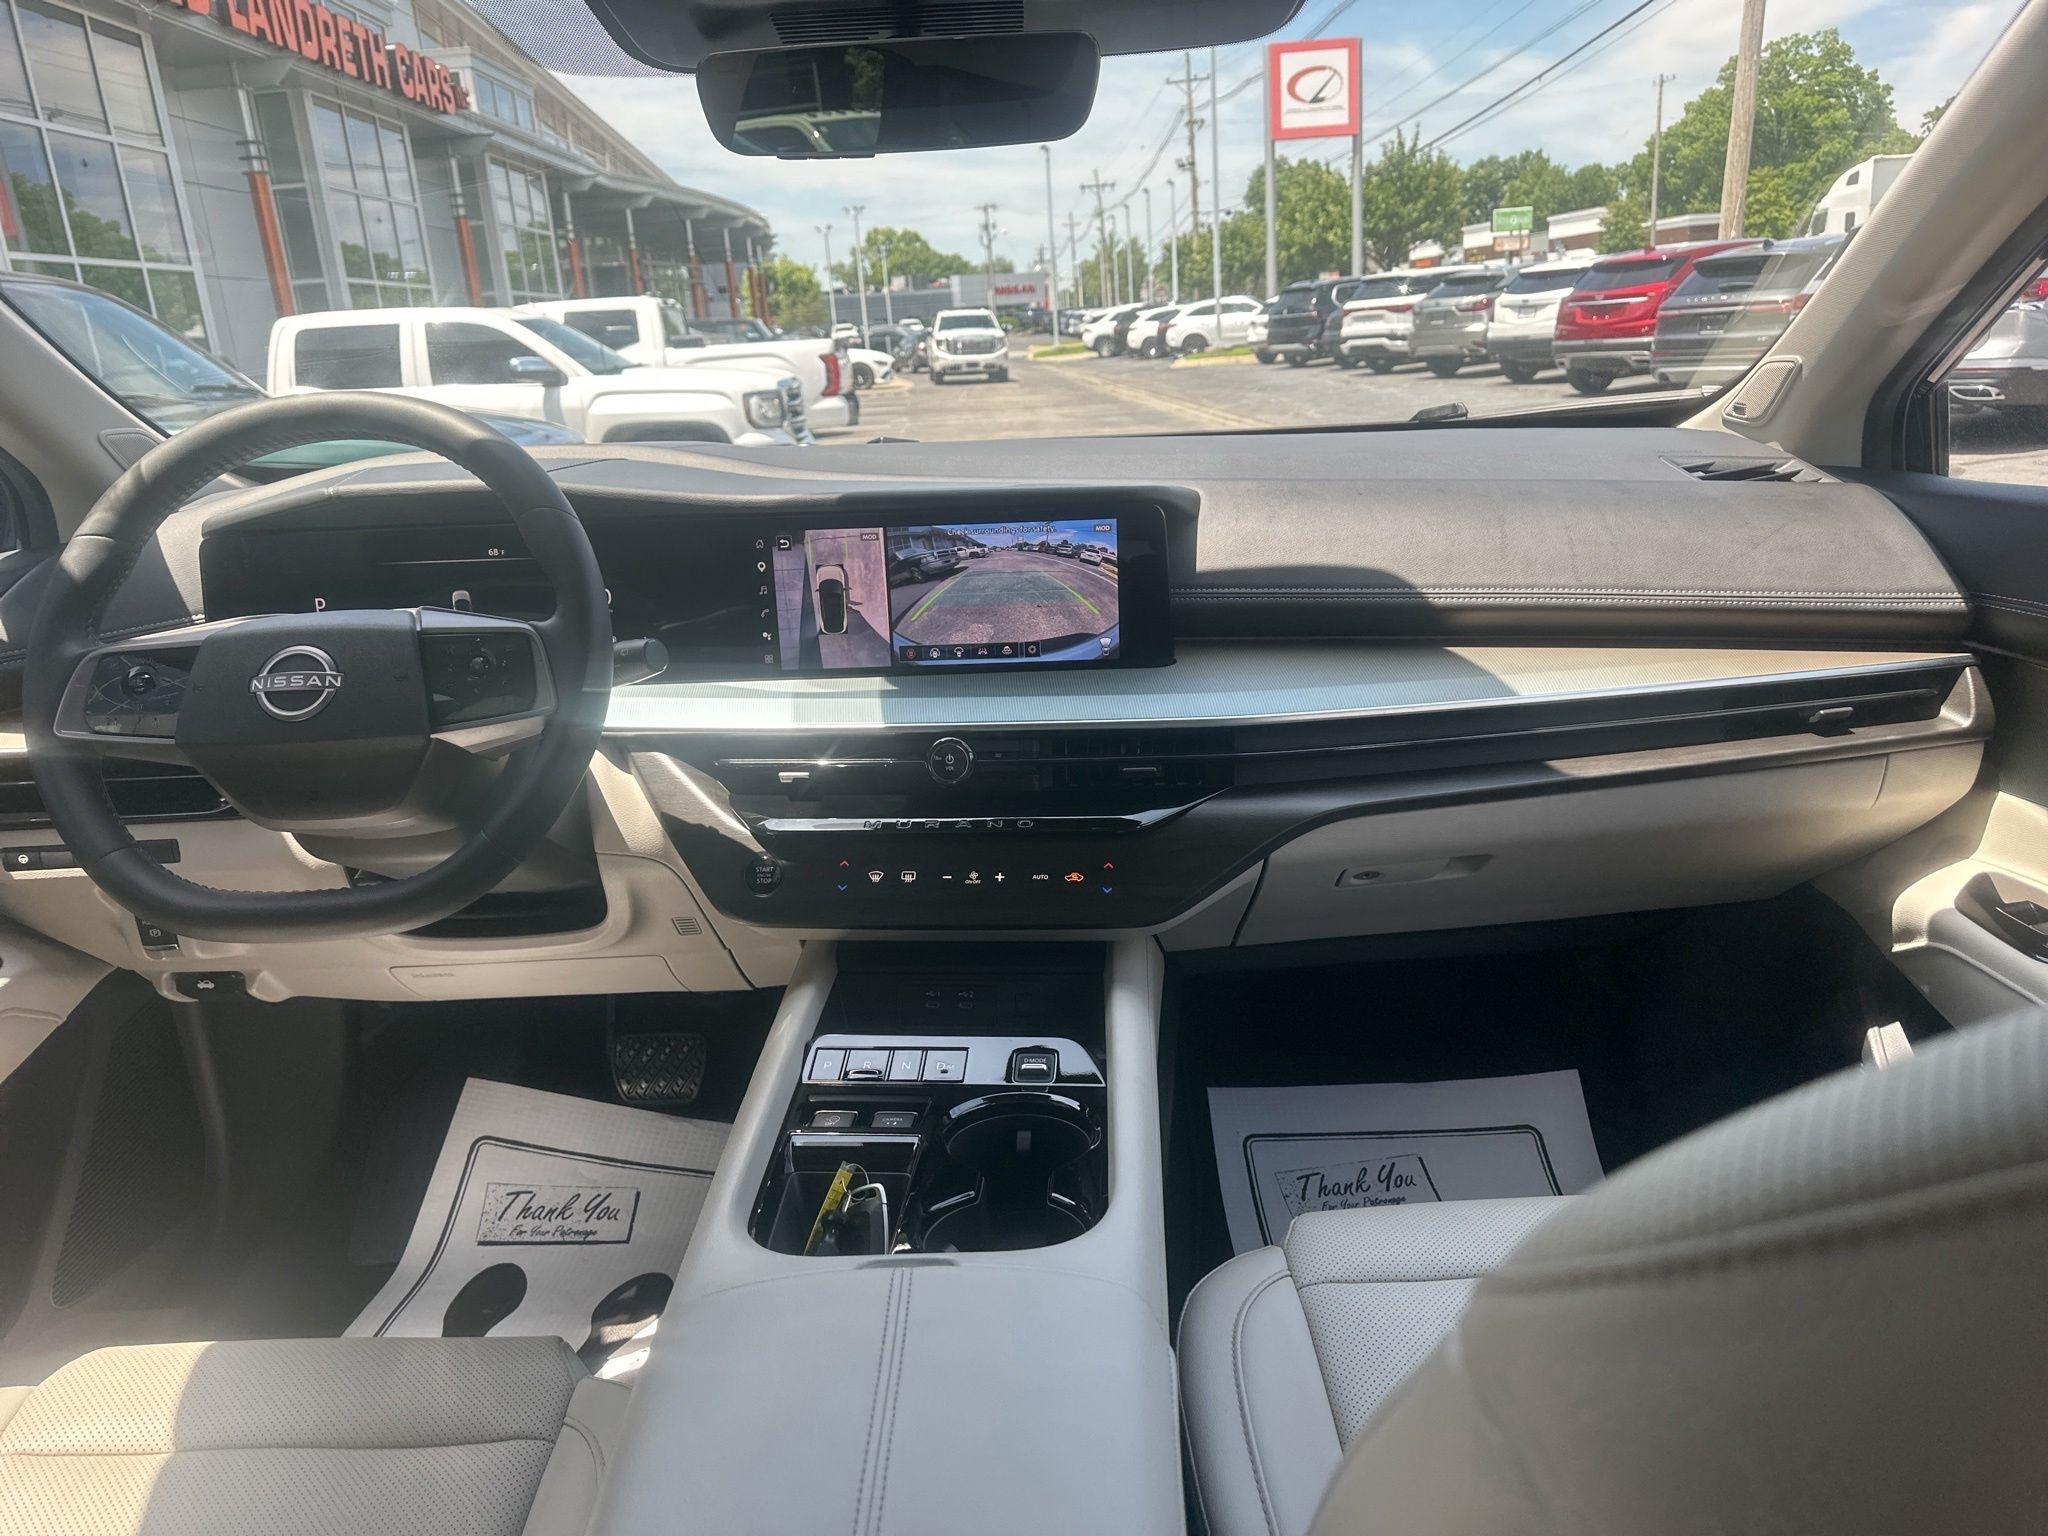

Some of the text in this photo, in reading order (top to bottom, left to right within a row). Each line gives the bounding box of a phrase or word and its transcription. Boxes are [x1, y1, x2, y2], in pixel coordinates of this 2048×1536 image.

[226, 0, 456, 115] LANDRETH CARS
[315, 598, 326, 612] P
[252, 673, 343, 692] NISSAN
[864, 819, 1034, 829] MURANO
[863, 1061, 872, 1069] R
[1296, 1162, 1416, 1202] Thank You
[498, 1191, 621, 1222] Thank You
[509, 1225, 598, 1239] For Your Patronage
